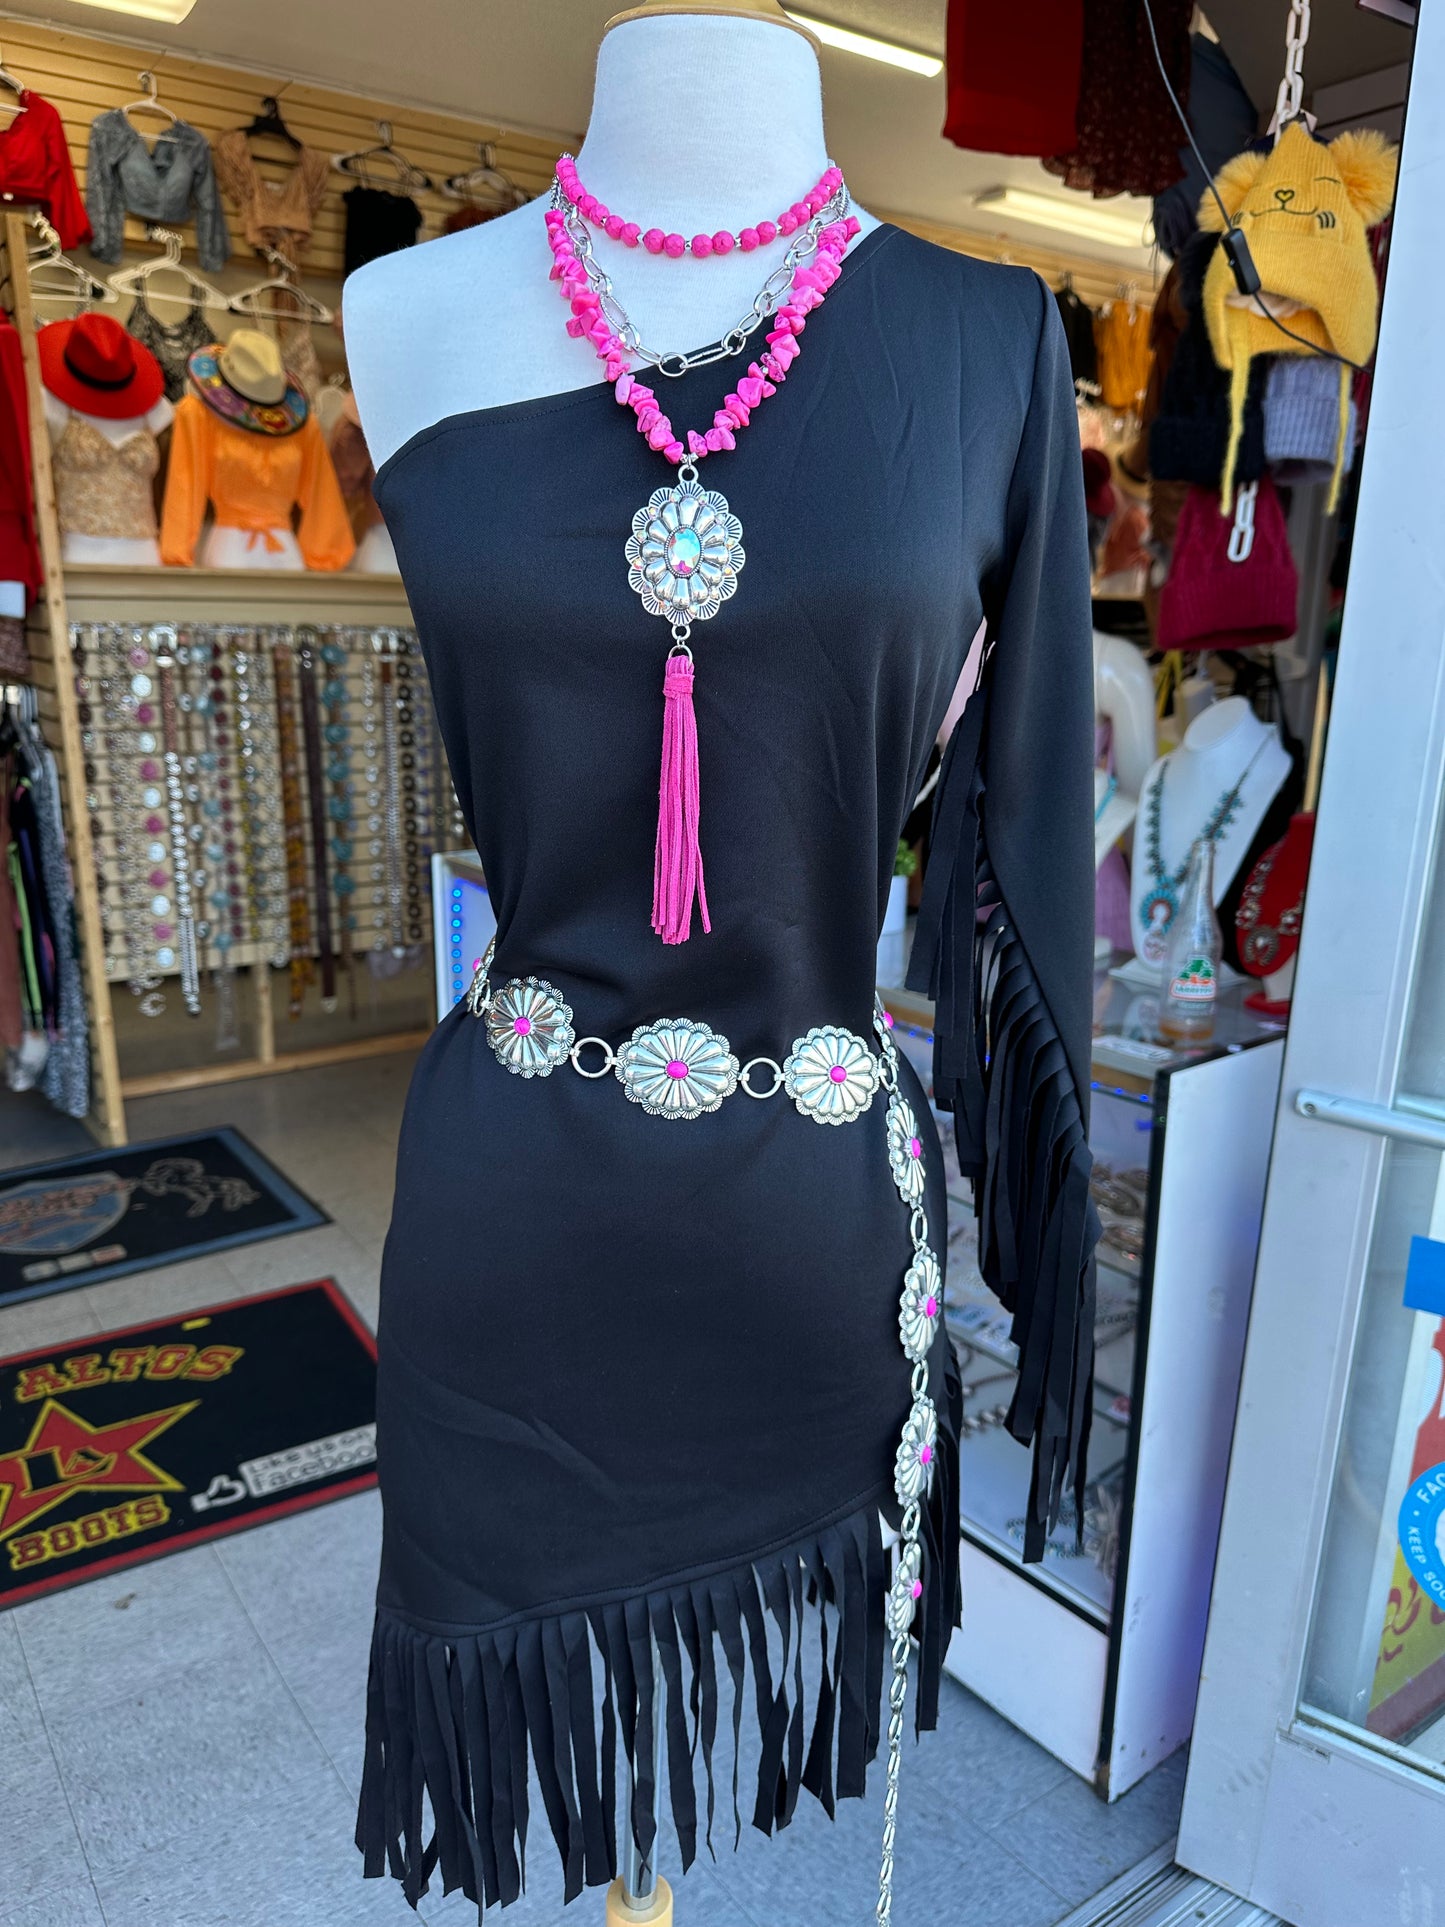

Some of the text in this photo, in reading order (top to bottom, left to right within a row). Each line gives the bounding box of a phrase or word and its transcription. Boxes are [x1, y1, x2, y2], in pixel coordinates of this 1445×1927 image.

[16, 1345, 244, 1402] ALTOS
[252, 1444, 377, 1491] Faceboo
[7, 1495, 171, 1570] BOOTS
[1408, 1525, 1427, 1564] KEEP
